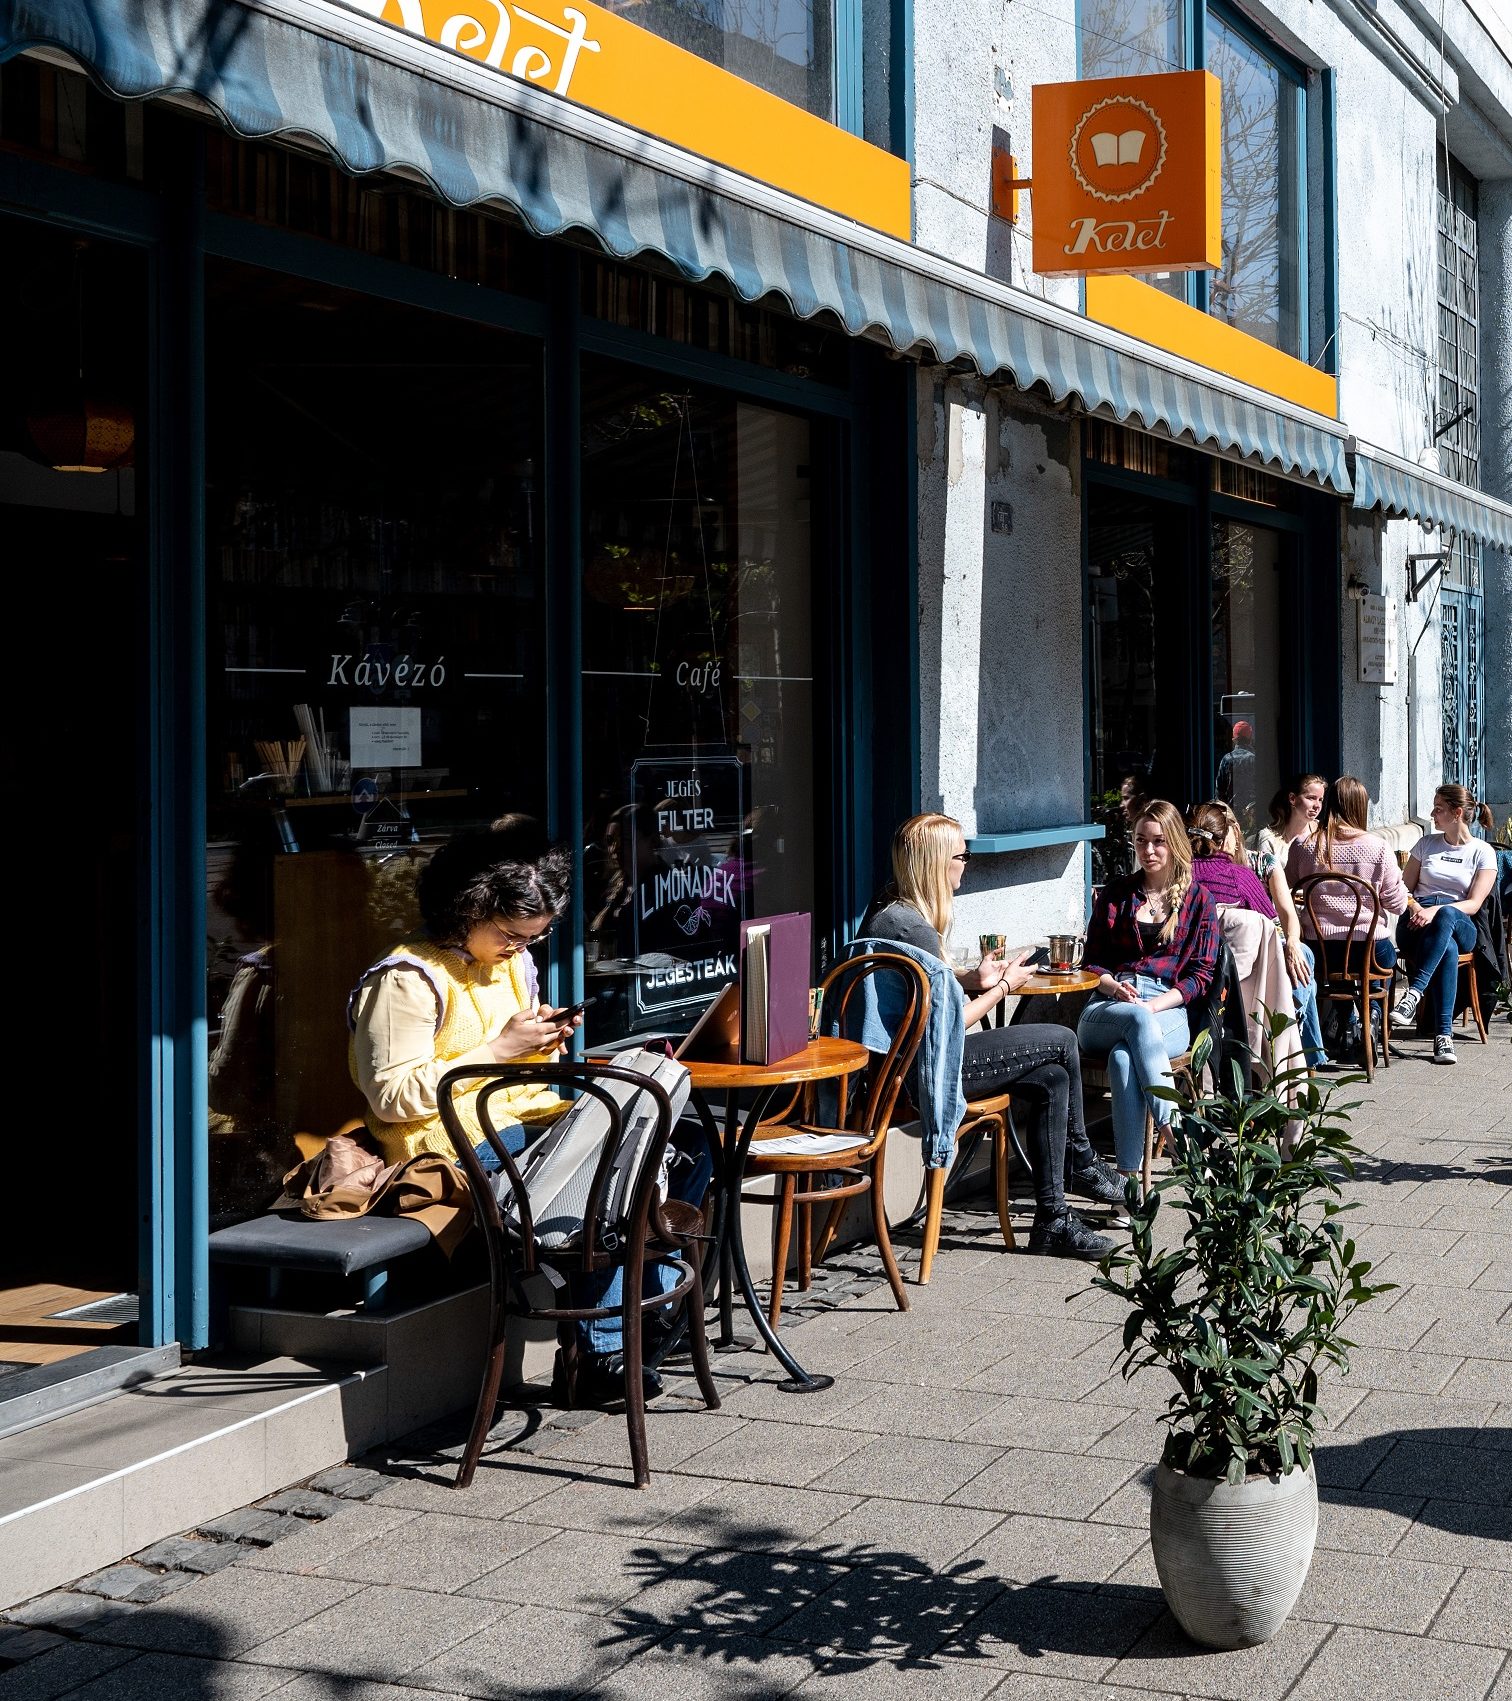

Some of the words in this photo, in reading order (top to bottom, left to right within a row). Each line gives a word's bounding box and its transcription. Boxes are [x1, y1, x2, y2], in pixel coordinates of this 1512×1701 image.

[1063, 209, 1176, 255] Kelet
[326, 653, 446, 687] Kávézó
[676, 661, 721, 694] Café
[664, 779, 702, 798] JEGES
[376, 824, 399, 833] Zárva
[657, 807, 715, 832] FILTER
[375, 840, 398, 850] Closed
[641, 857, 737, 920] LIMONÁDÉK
[646, 951, 738, 990] JEGESTEÁK
